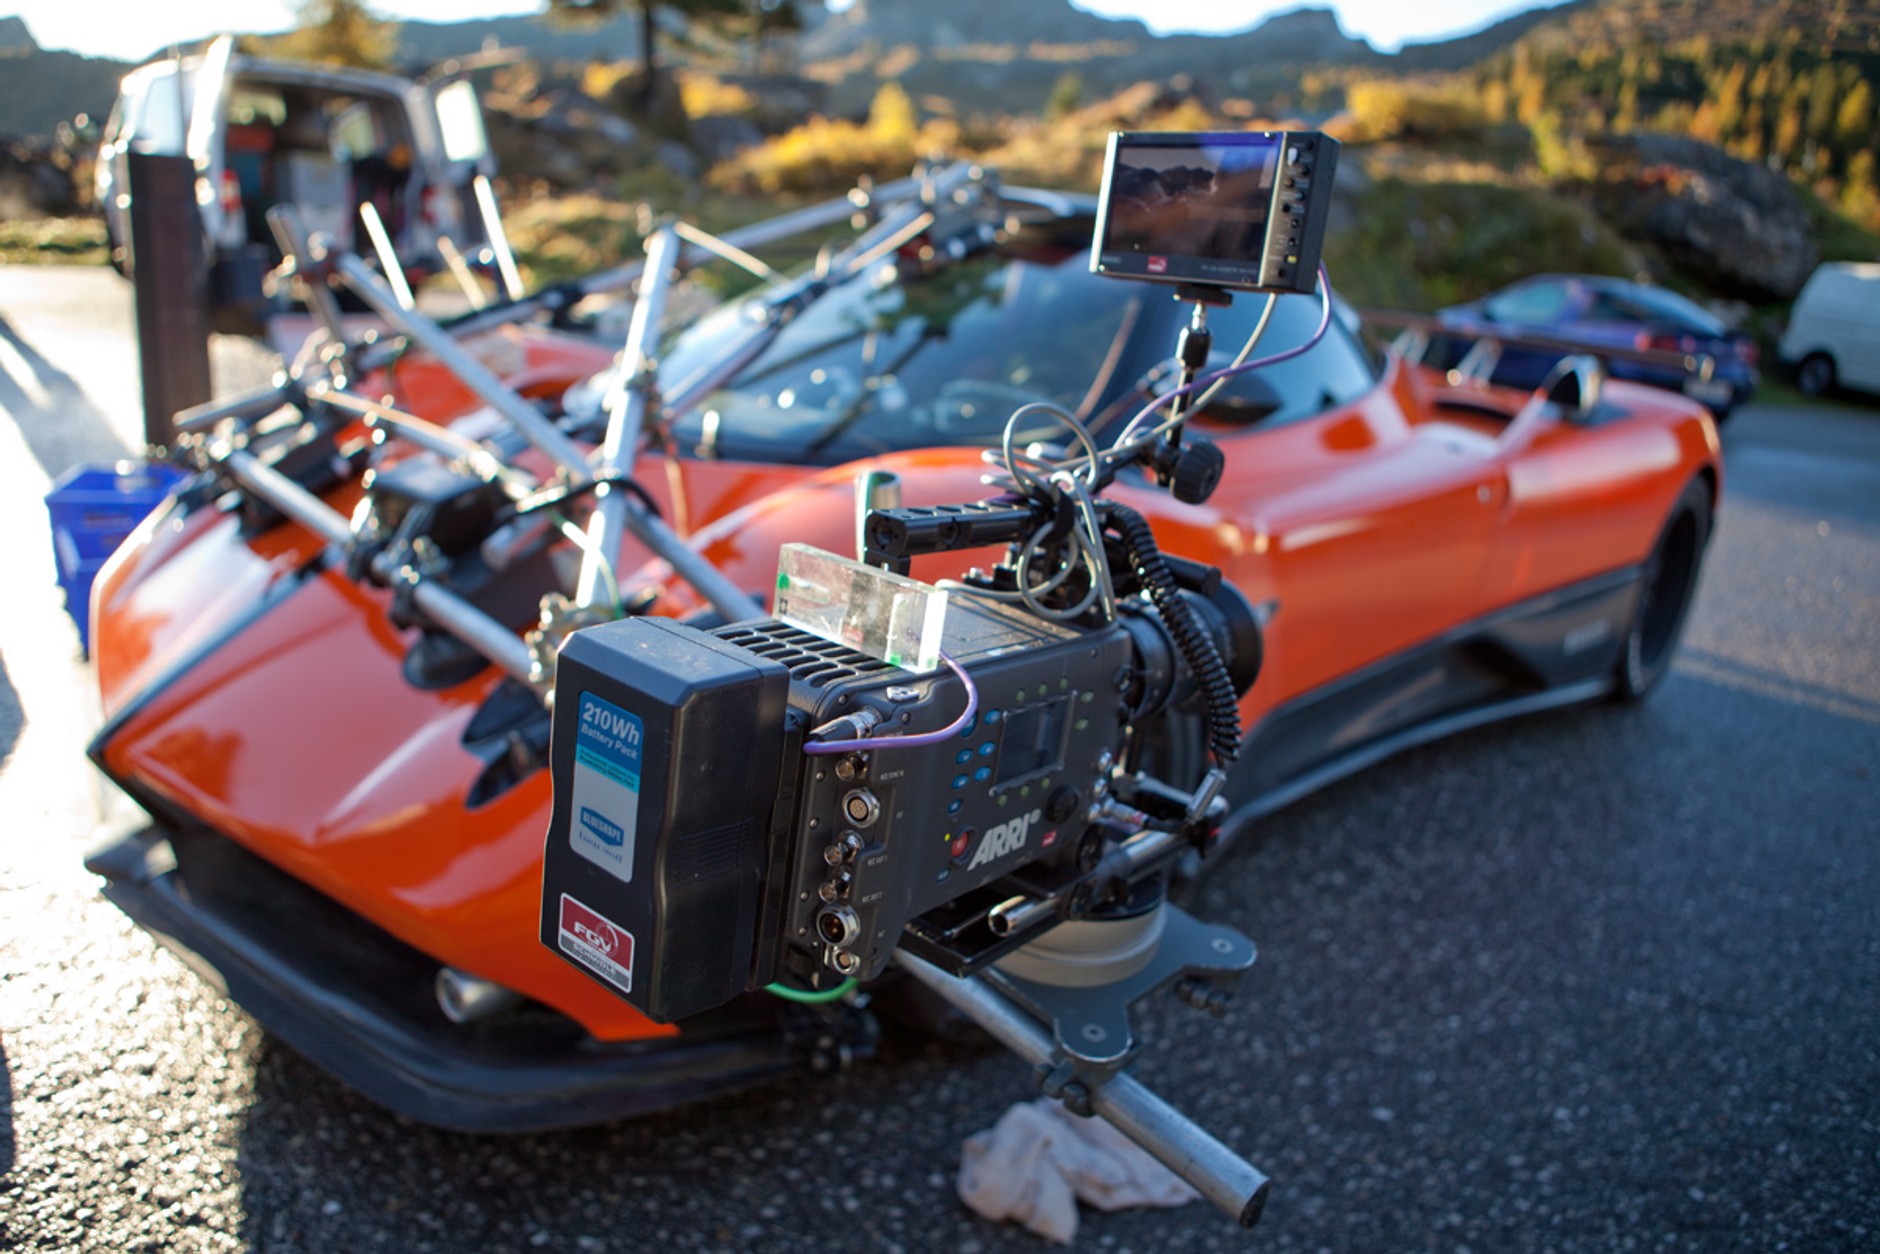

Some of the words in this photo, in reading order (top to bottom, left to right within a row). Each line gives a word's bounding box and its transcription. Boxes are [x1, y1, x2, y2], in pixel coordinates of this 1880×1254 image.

[580, 723, 613, 749] Battery
[614, 742, 638, 760] Pack
[582, 702, 640, 746] 210Wh
[574, 921, 611, 952] FGV
